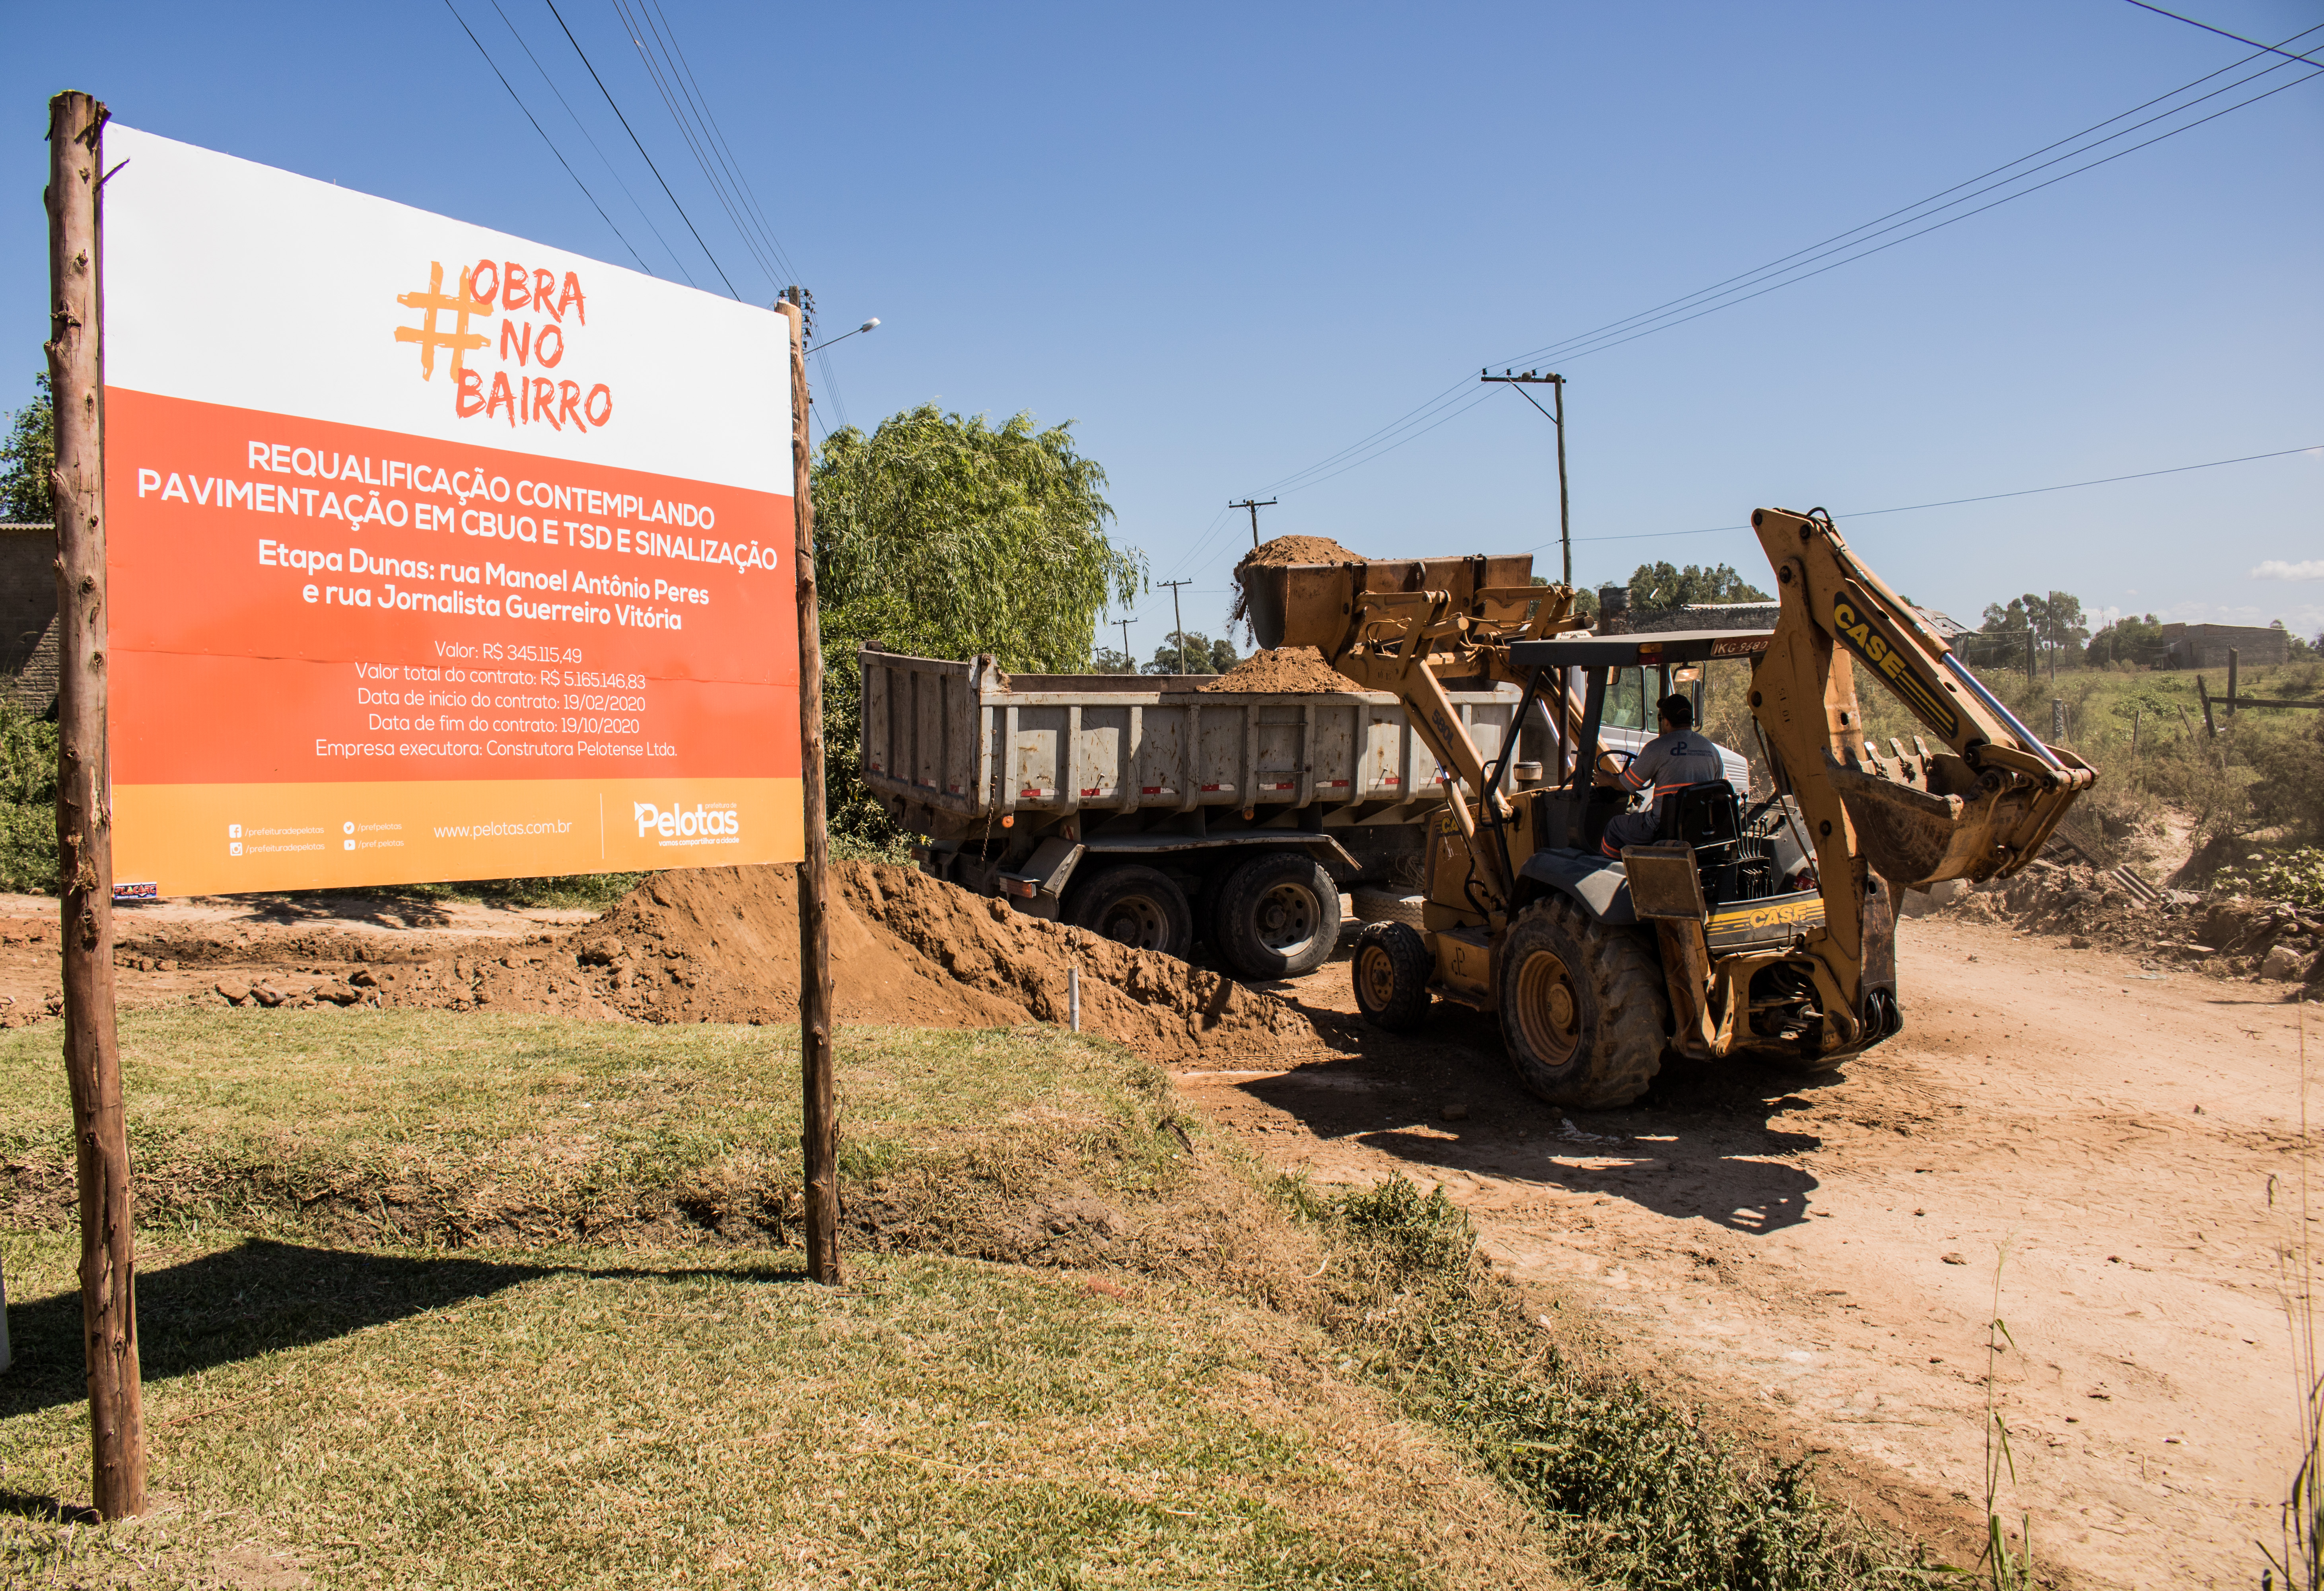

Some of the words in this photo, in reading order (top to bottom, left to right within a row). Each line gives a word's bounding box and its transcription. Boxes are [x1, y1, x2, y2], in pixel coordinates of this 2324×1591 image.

[500, 319, 564, 368] NO
[456, 367, 613, 434] BAIRRO
[249, 441, 510, 506] REQUALIFICAÇÃO
[517, 480, 714, 529] CONTEMPLANDO
[138, 468, 408, 531] PAVIMENTAÇÃO
[416, 503, 454, 533] EM
[461, 510, 537, 543] CBUQ
[543, 519, 558, 544] E
[564, 521, 612, 550] TSD
[618, 528, 630, 552] E
[636, 531, 777, 574] SINALIZAÇÃO
[259, 539, 342, 576] Etapa
[350, 548, 434, 580] Dunas:
[441, 564, 480, 583] rua
[486, 562, 567, 591] Manoel
[572, 571, 650, 599] Antônio
[655, 579, 709, 605] Peres
[303, 584, 319, 603] e
[326, 586, 371, 607] rua
[377, 584, 500, 616] Jornalista
[506, 595, 611, 624] Guerreiro
[615, 604, 681, 630] Vitória
[435, 641, 478, 658] Valor:
[483, 642, 503, 661] R$
[508, 645, 581, 664] 345.115,49
[1713, 641, 1768, 654] IKG-9680
[1834, 603, 1906, 680] CASE
[355, 662, 399, 679] Valor
[404, 665, 440, 681] total
[445, 666, 465, 682] do
[470, 670, 536, 685] contrato:
[541, 669, 560, 687] R$
[564, 671, 645, 689] 5.165.146,83
[358, 688, 399, 704] Data
[405, 690, 424, 705] de
[430, 690, 466, 706] início
[471, 692, 490, 707] do
[495, 694, 559, 709] contrato:
[564, 694, 645, 712] 19/02/2020
[370, 714, 410, 730] Data
[415, 715, 434, 730] de
[440, 715, 464, 731] fim
[469, 716, 488, 731] do
[493, 718, 557, 732] contrato:
[561, 717, 639, 734] 19/10/2020
[1432, 708, 1454, 751] 580L
[316, 739, 394, 759] Empresa
[400, 741, 482, 755] executora:
[487, 740, 573, 755] Construtora
[578, 741, 643, 756] Pelotense
[647, 742, 677, 756] Ltda.
[358, 823, 402, 832] /prefpelotas
[434, 819, 572, 840] www.pelotas.com.br
[634, 801, 739, 837] Pelotas
[245, 827, 324, 837] /prefeituradepelotas
[679, 837, 715, 847] compartilhar
[246, 843, 325, 854] /prefeituradepelotas
[358, 840, 404, 849] /pref.pelotas
[1749, 903, 1807, 928] CASE
